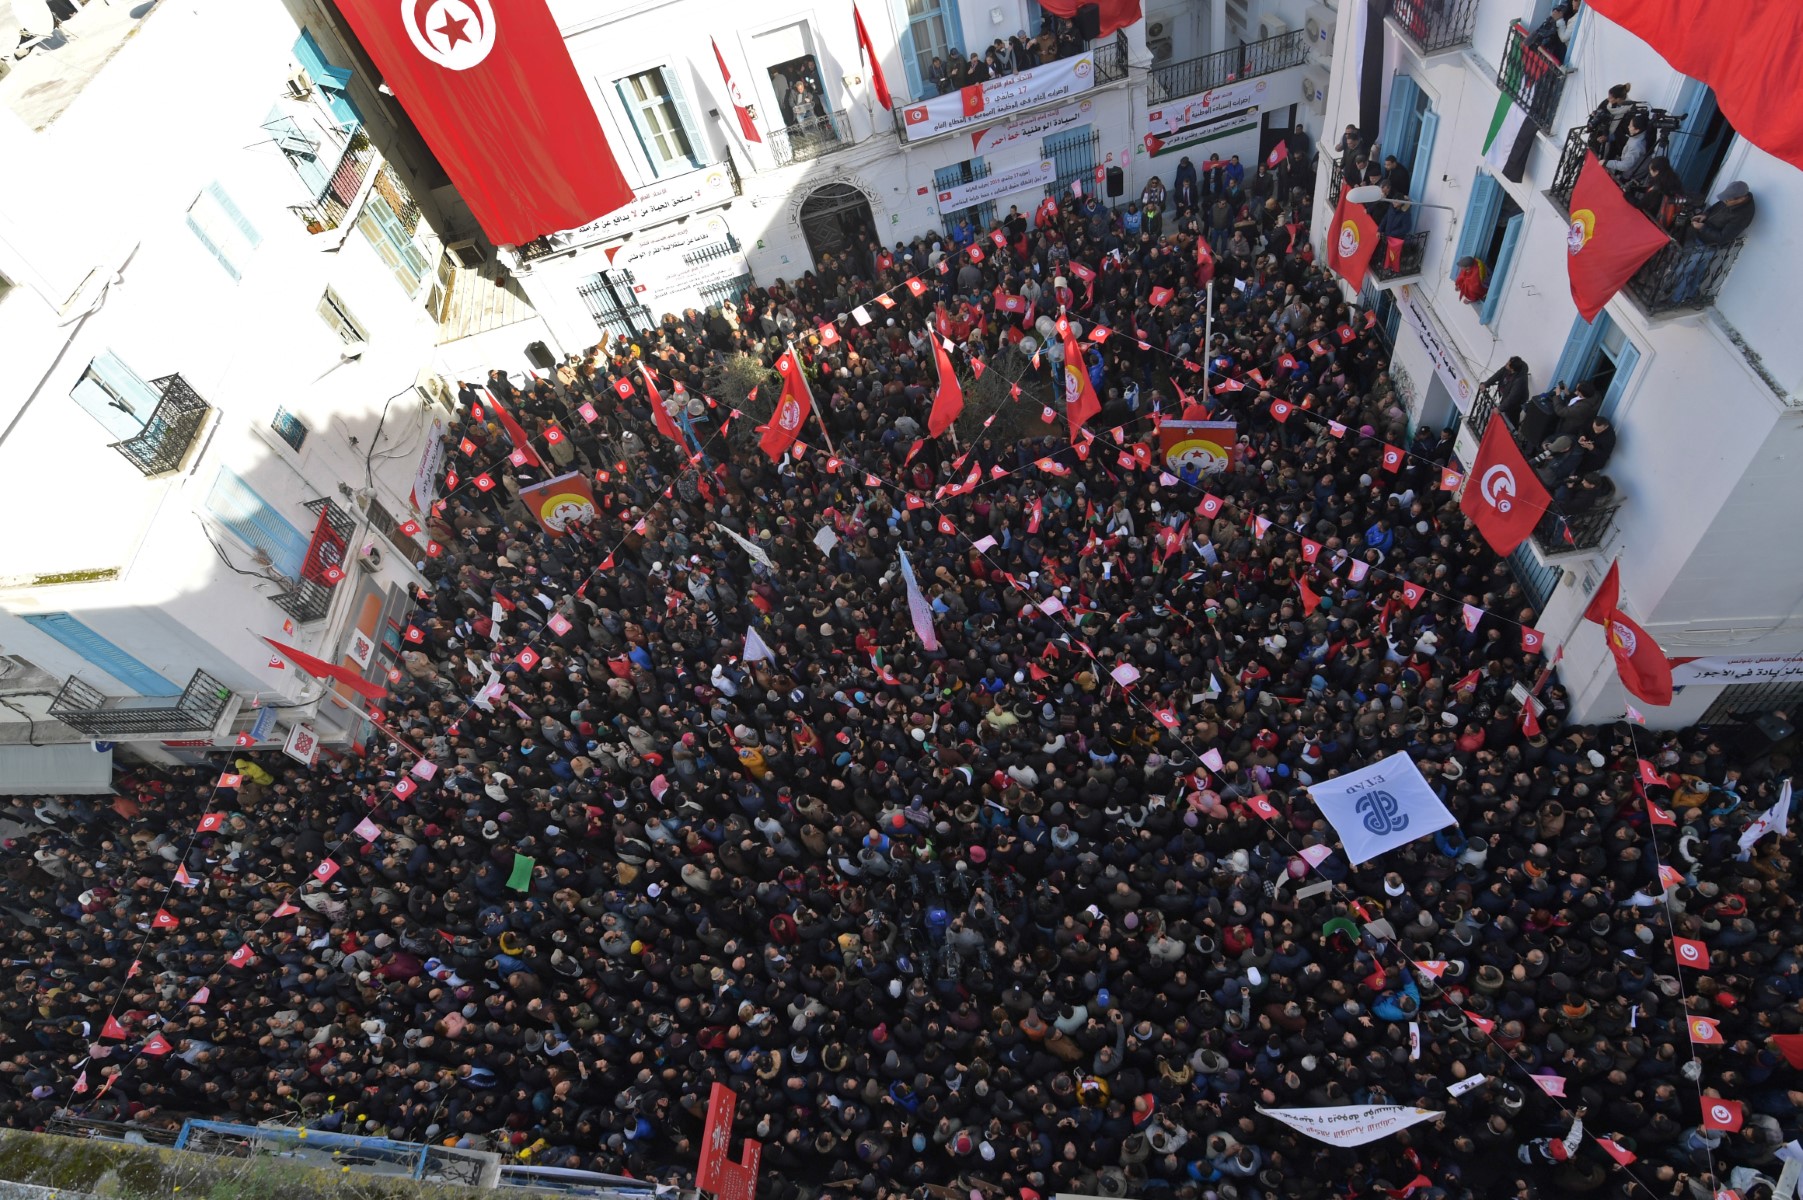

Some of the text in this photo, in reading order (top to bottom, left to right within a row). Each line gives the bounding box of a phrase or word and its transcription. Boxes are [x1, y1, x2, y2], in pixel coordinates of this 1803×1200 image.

[1017, 85, 1028, 95] 17
[1053, 112, 1080, 127] السيادة
[1021, 121, 1052, 137] الوطنية
[650, 201, 670, 212] الحياة
[672, 195, 693, 207] يستحق
[640, 209, 649, 217] من
[601, 220, 611, 228] عن
[612, 214, 631, 226] يدافع
[577, 222, 600, 233] كرامته
[1734, 668, 1753, 678] في
